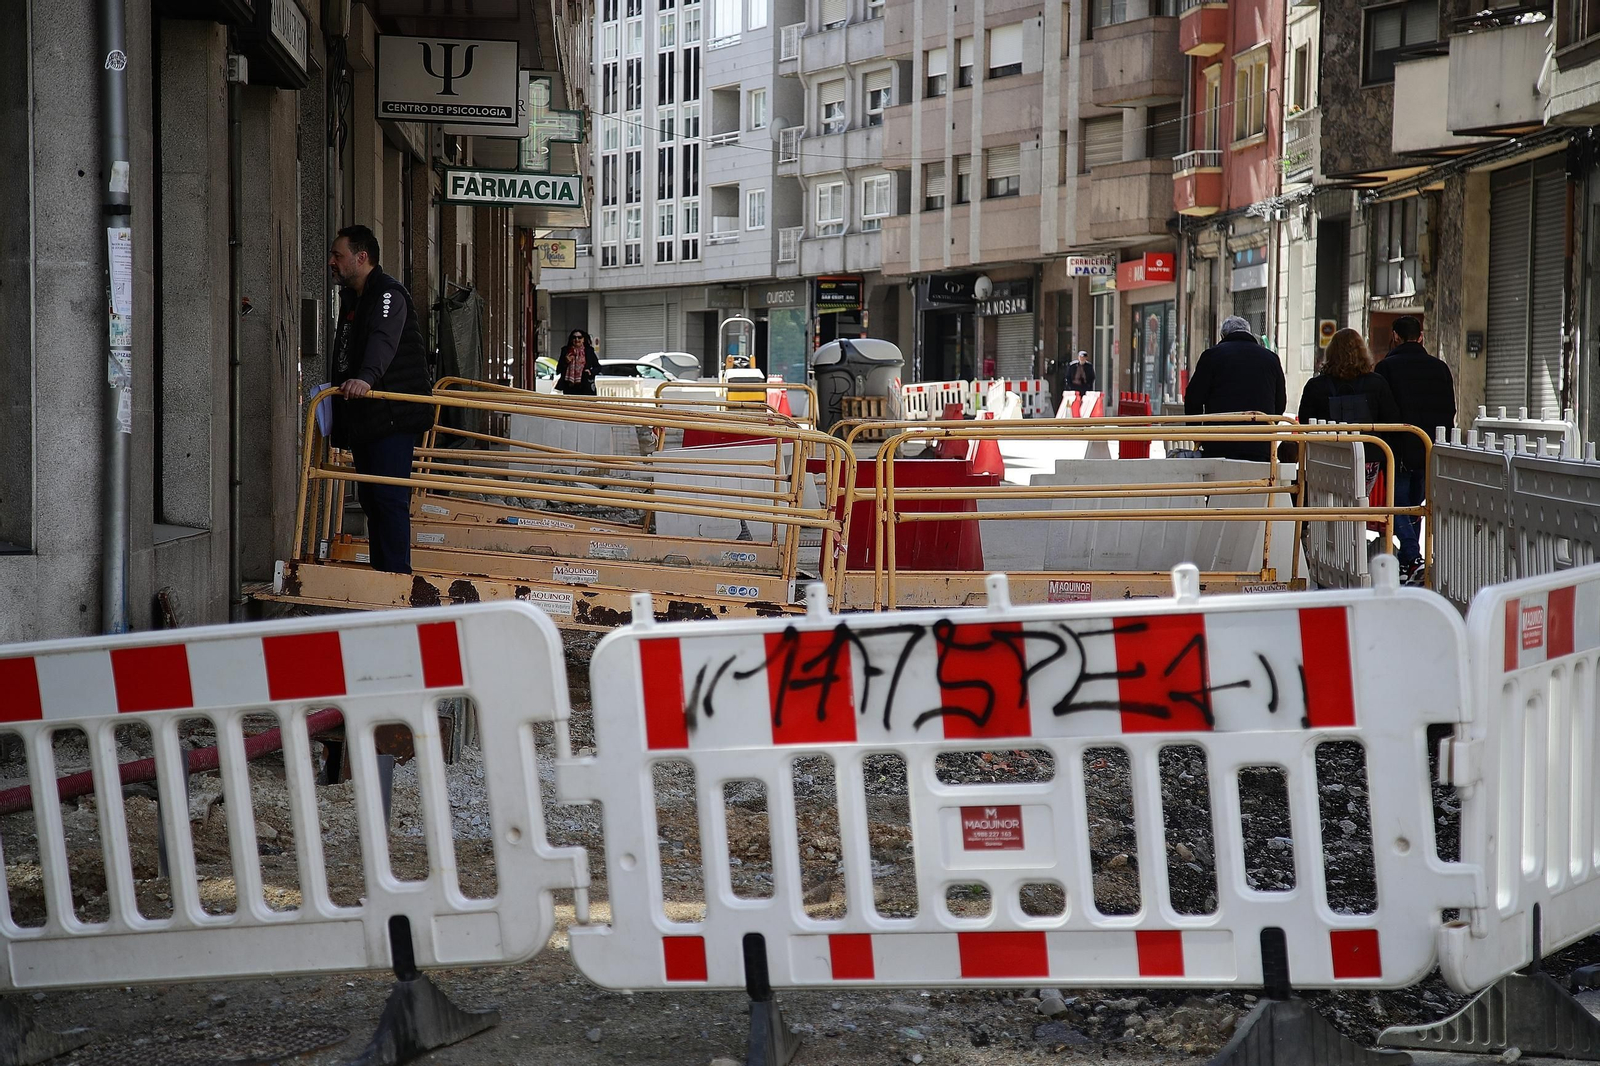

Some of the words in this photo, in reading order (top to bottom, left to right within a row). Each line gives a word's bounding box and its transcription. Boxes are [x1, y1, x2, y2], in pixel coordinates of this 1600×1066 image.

[387, 104, 428, 113] CENTRO
[430, 105, 444, 114] DE
[446, 106, 507, 116] PSICOLOGIA
[451, 176, 575, 201] FARMACIA
[1074, 266, 1107, 274] PACO
[554, 566, 598, 575] MAQUINOR
[1049, 581, 1091, 593] MAQUINOR
[1243, 584, 1287, 594] MAQUINOR
[965, 820, 1020, 829] MAQUINOR
